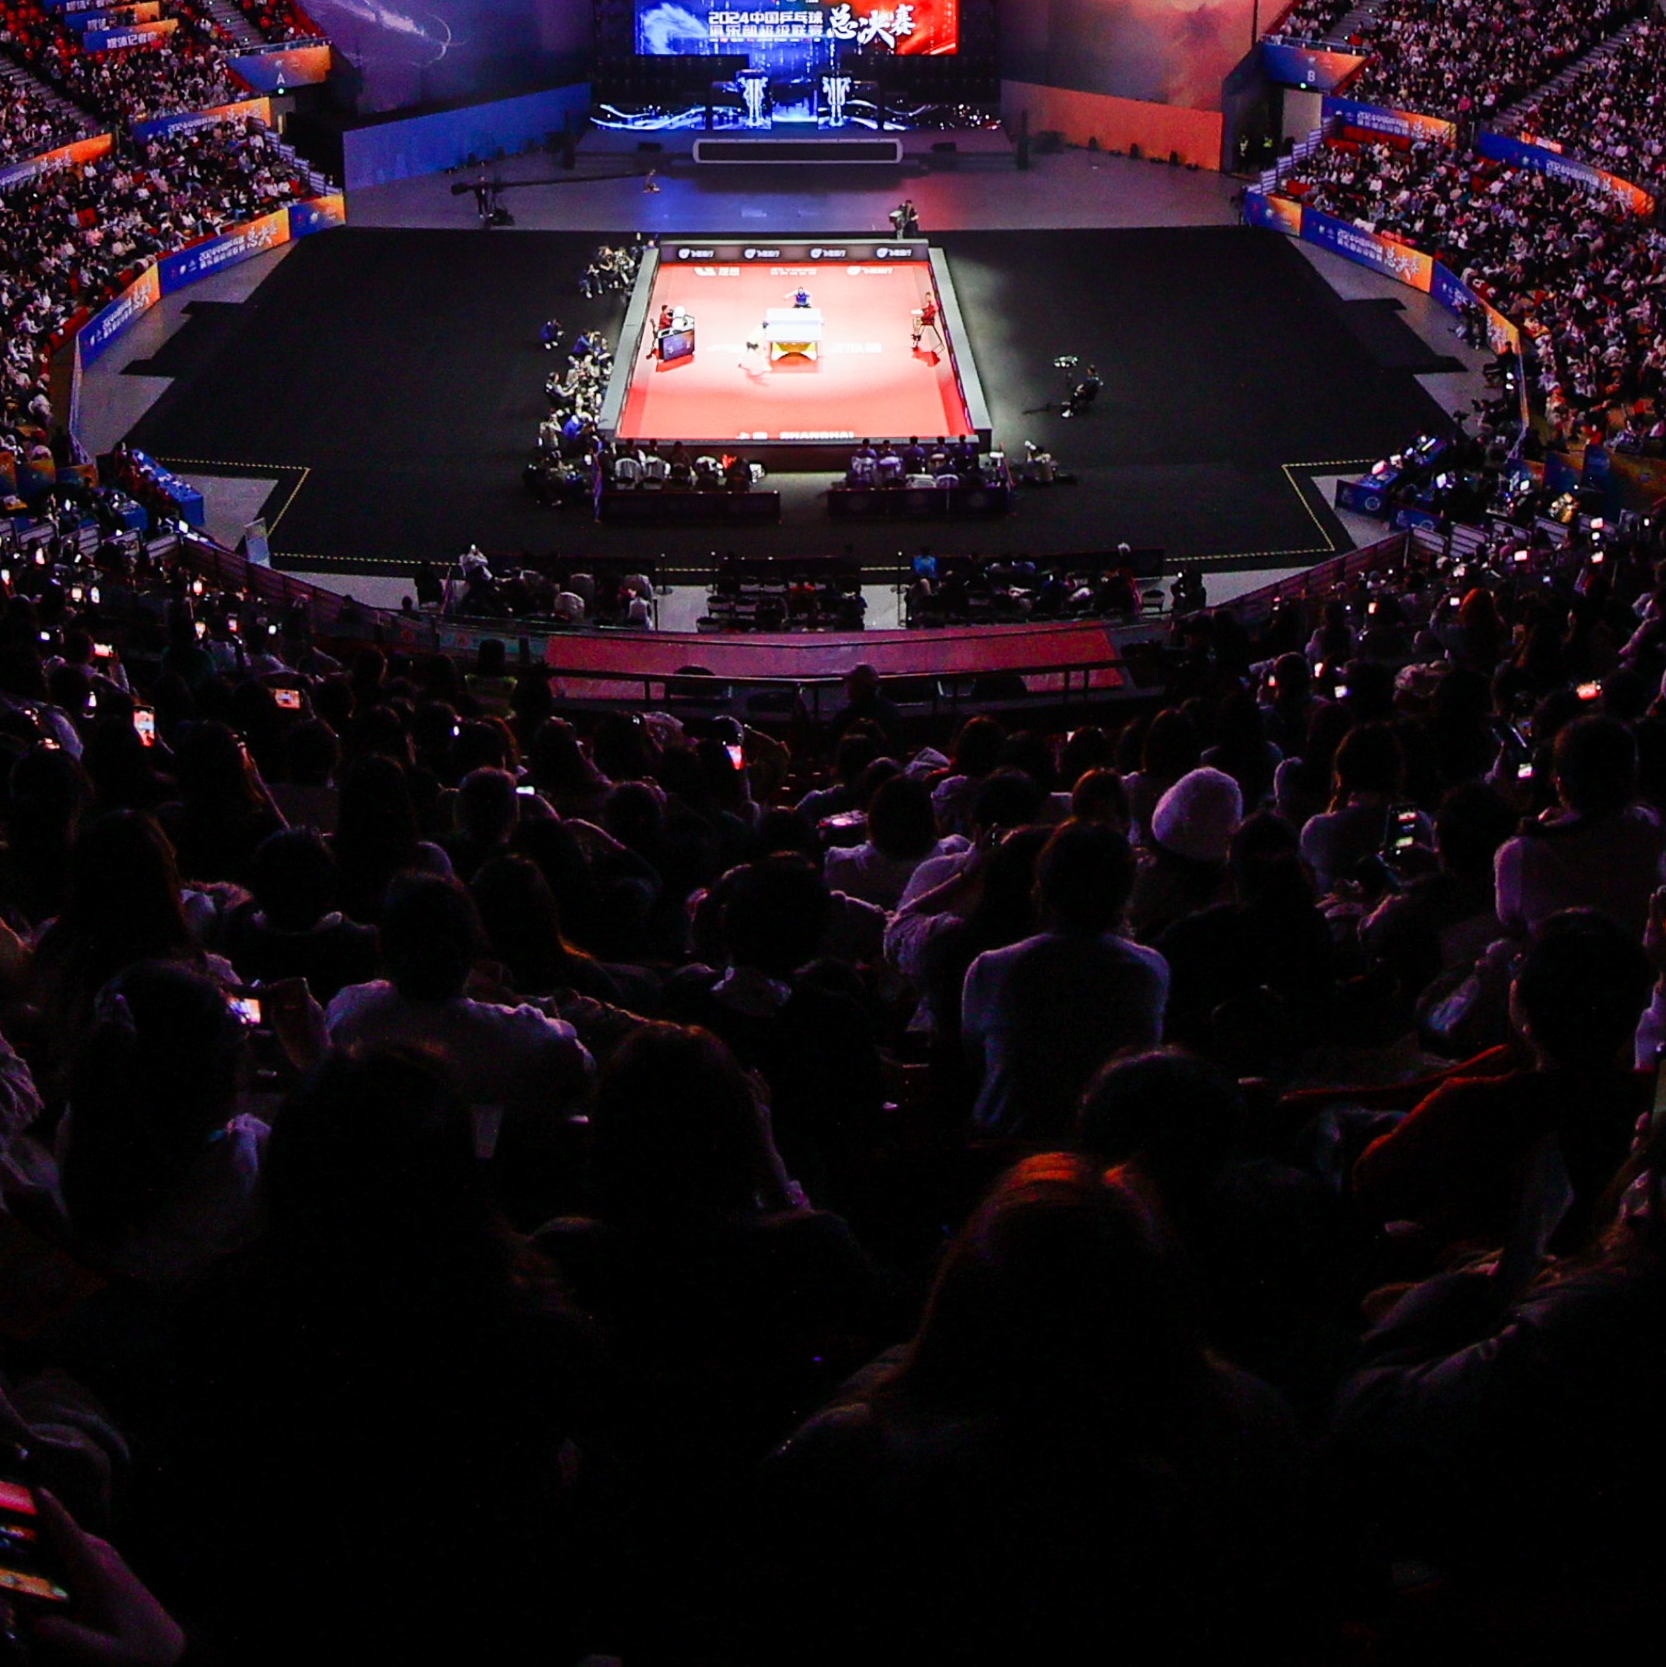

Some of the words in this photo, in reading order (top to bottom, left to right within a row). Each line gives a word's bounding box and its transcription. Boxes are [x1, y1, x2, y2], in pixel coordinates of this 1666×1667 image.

[708, 11, 823, 24] 2024中国乒乓球
[826, 3, 916, 48] 总决赛
[276, 72, 286, 85] A
